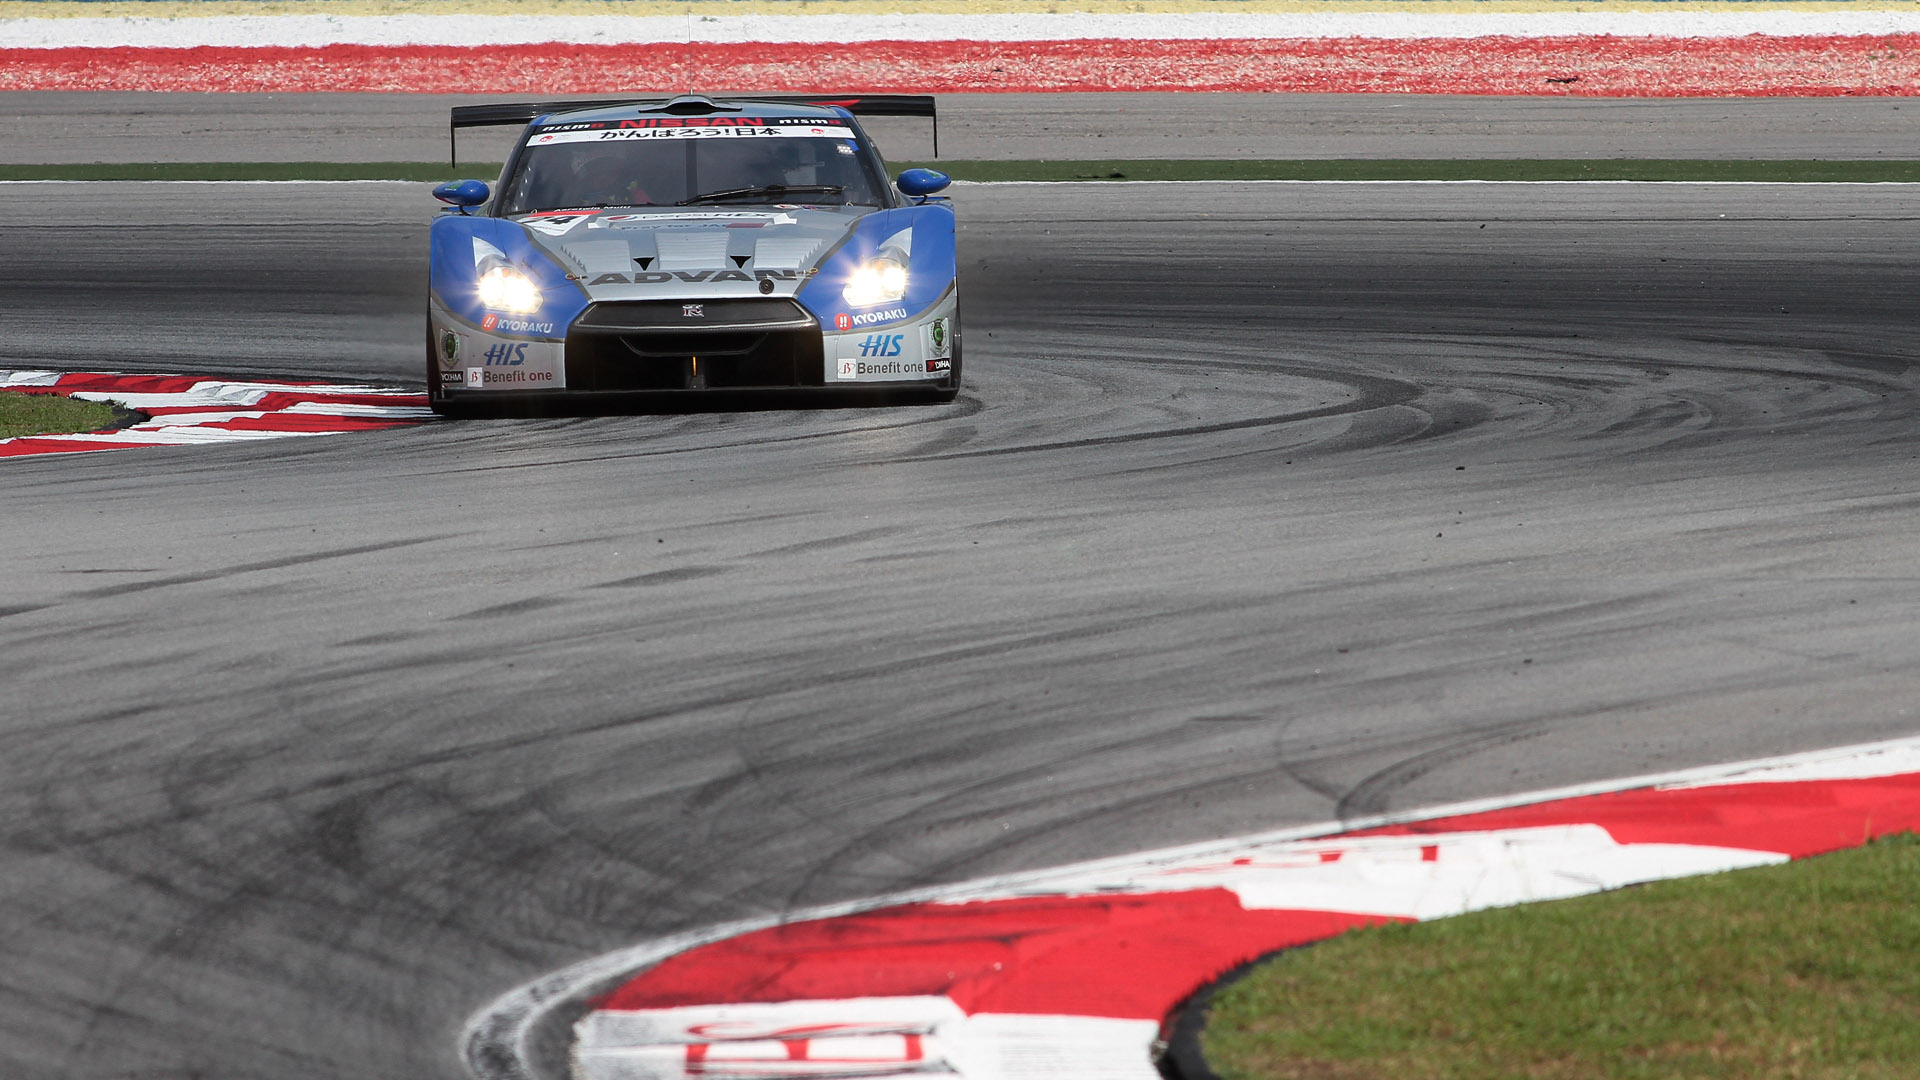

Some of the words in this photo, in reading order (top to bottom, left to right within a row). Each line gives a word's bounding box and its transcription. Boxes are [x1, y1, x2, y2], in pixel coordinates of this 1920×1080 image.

[542, 123, 604, 132] nismo
[619, 117, 764, 128] NISSAN
[588, 270, 798, 286] ADVAN
[852, 308, 907, 326] KYORAKU
[497, 319, 553, 334] KYORAKU
[857, 361, 901, 374] Benefit
[903, 362, 924, 373] one
[483, 370, 526, 383] Benefit
[529, 371, 553, 382] one
